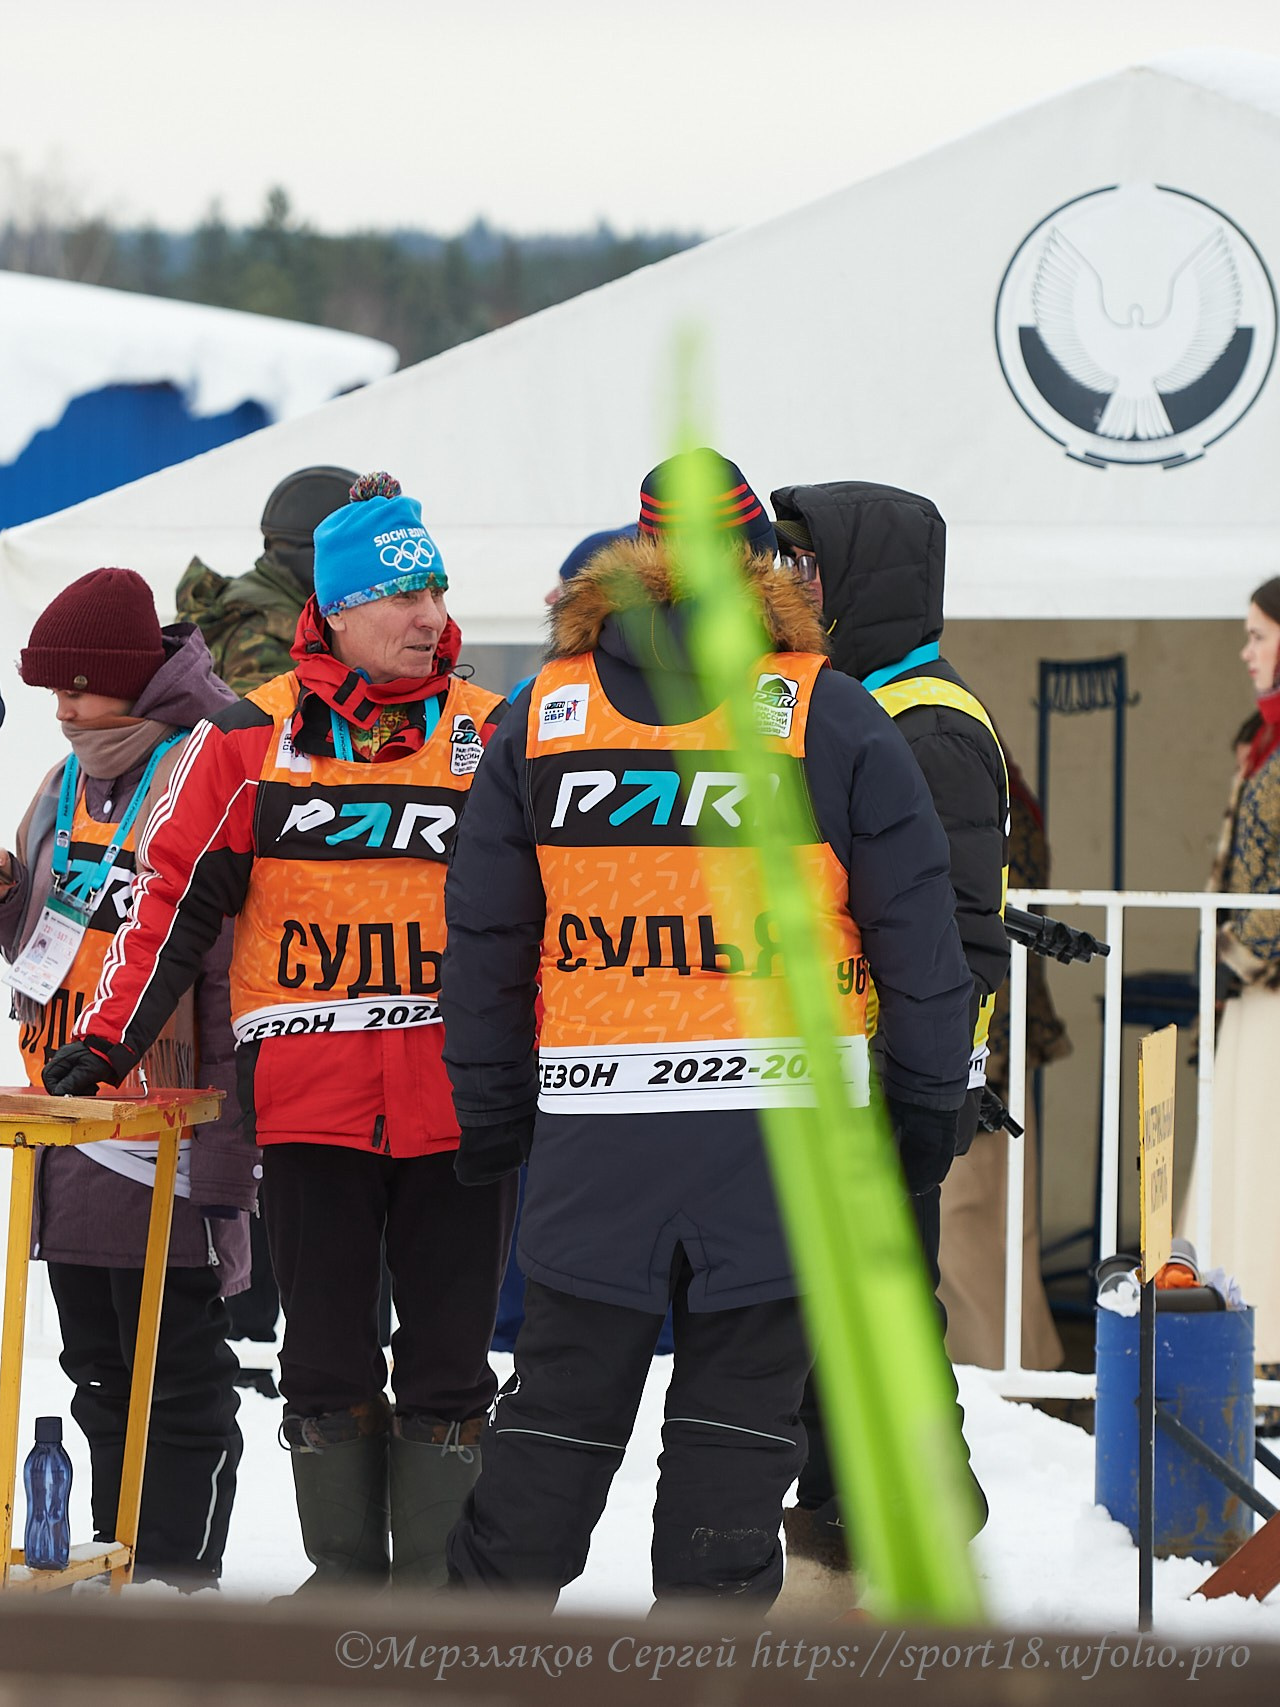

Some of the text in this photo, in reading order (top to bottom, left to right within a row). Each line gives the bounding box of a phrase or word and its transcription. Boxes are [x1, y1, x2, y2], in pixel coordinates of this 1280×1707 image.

[373, 528, 409, 547] SOCHI
[275, 798, 457, 854] PAR
[277, 919, 443, 1000] СУДЬ
[836, 953, 869, 996] 96
[539, 1053, 843, 1089] СЕЗОН 2022-20
